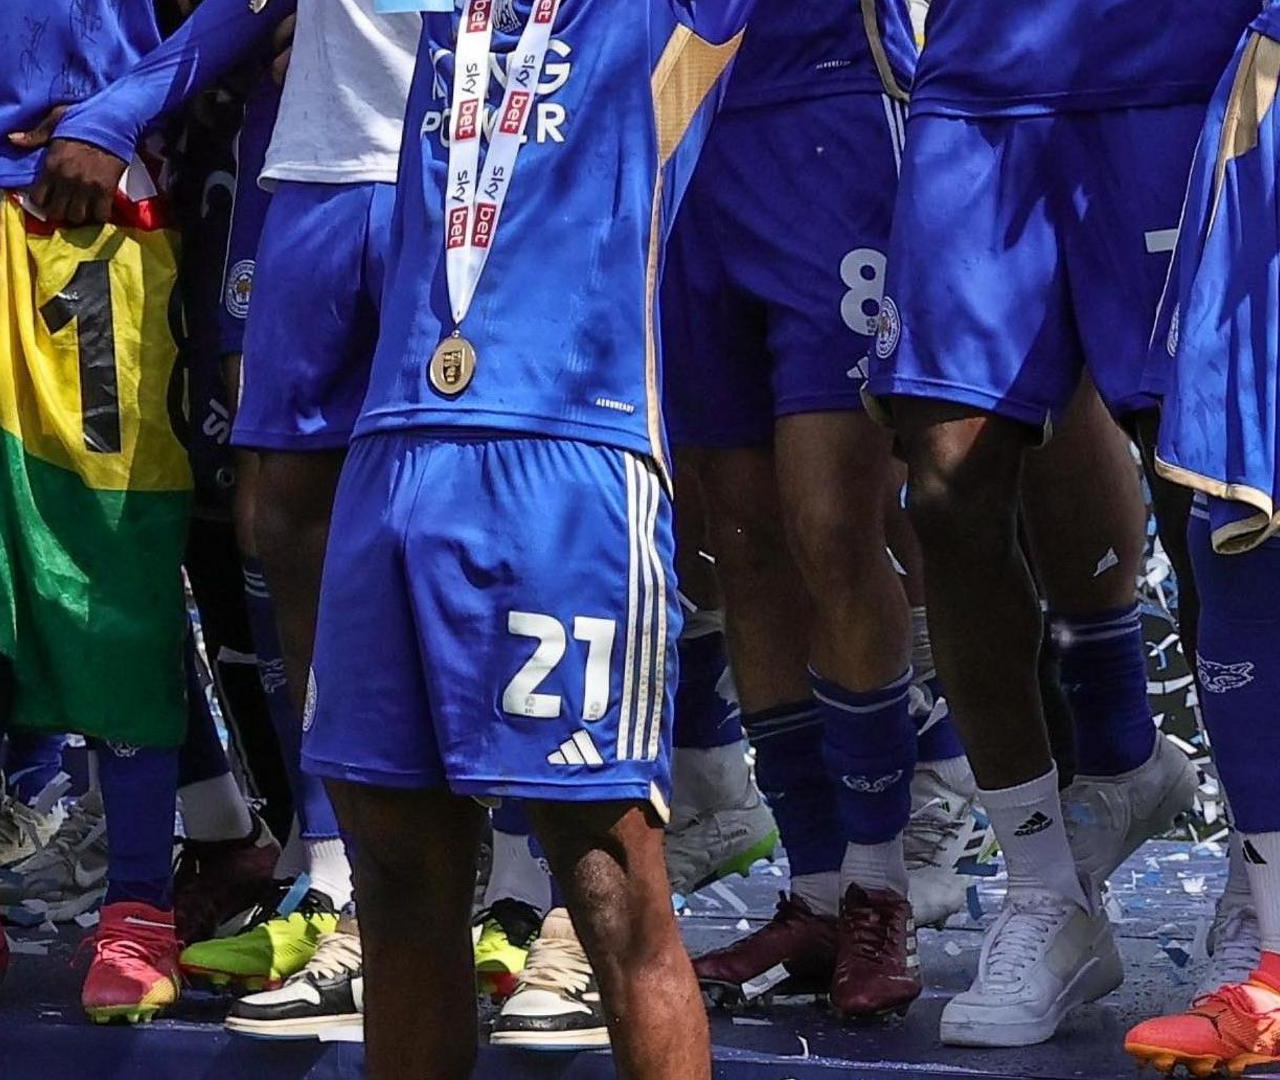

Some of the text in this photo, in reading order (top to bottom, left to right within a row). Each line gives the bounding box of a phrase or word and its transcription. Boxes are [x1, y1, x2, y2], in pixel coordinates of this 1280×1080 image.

[469, 0, 490, 31] bet
[458, 62, 479, 138] sky bet
[502, 54, 535, 132] sky bet
[449, 170, 470, 246] sky bet
[473, 166, 504, 245] sky bet
[840, 248, 887, 336] 8
[503, 610, 616, 721] 21
